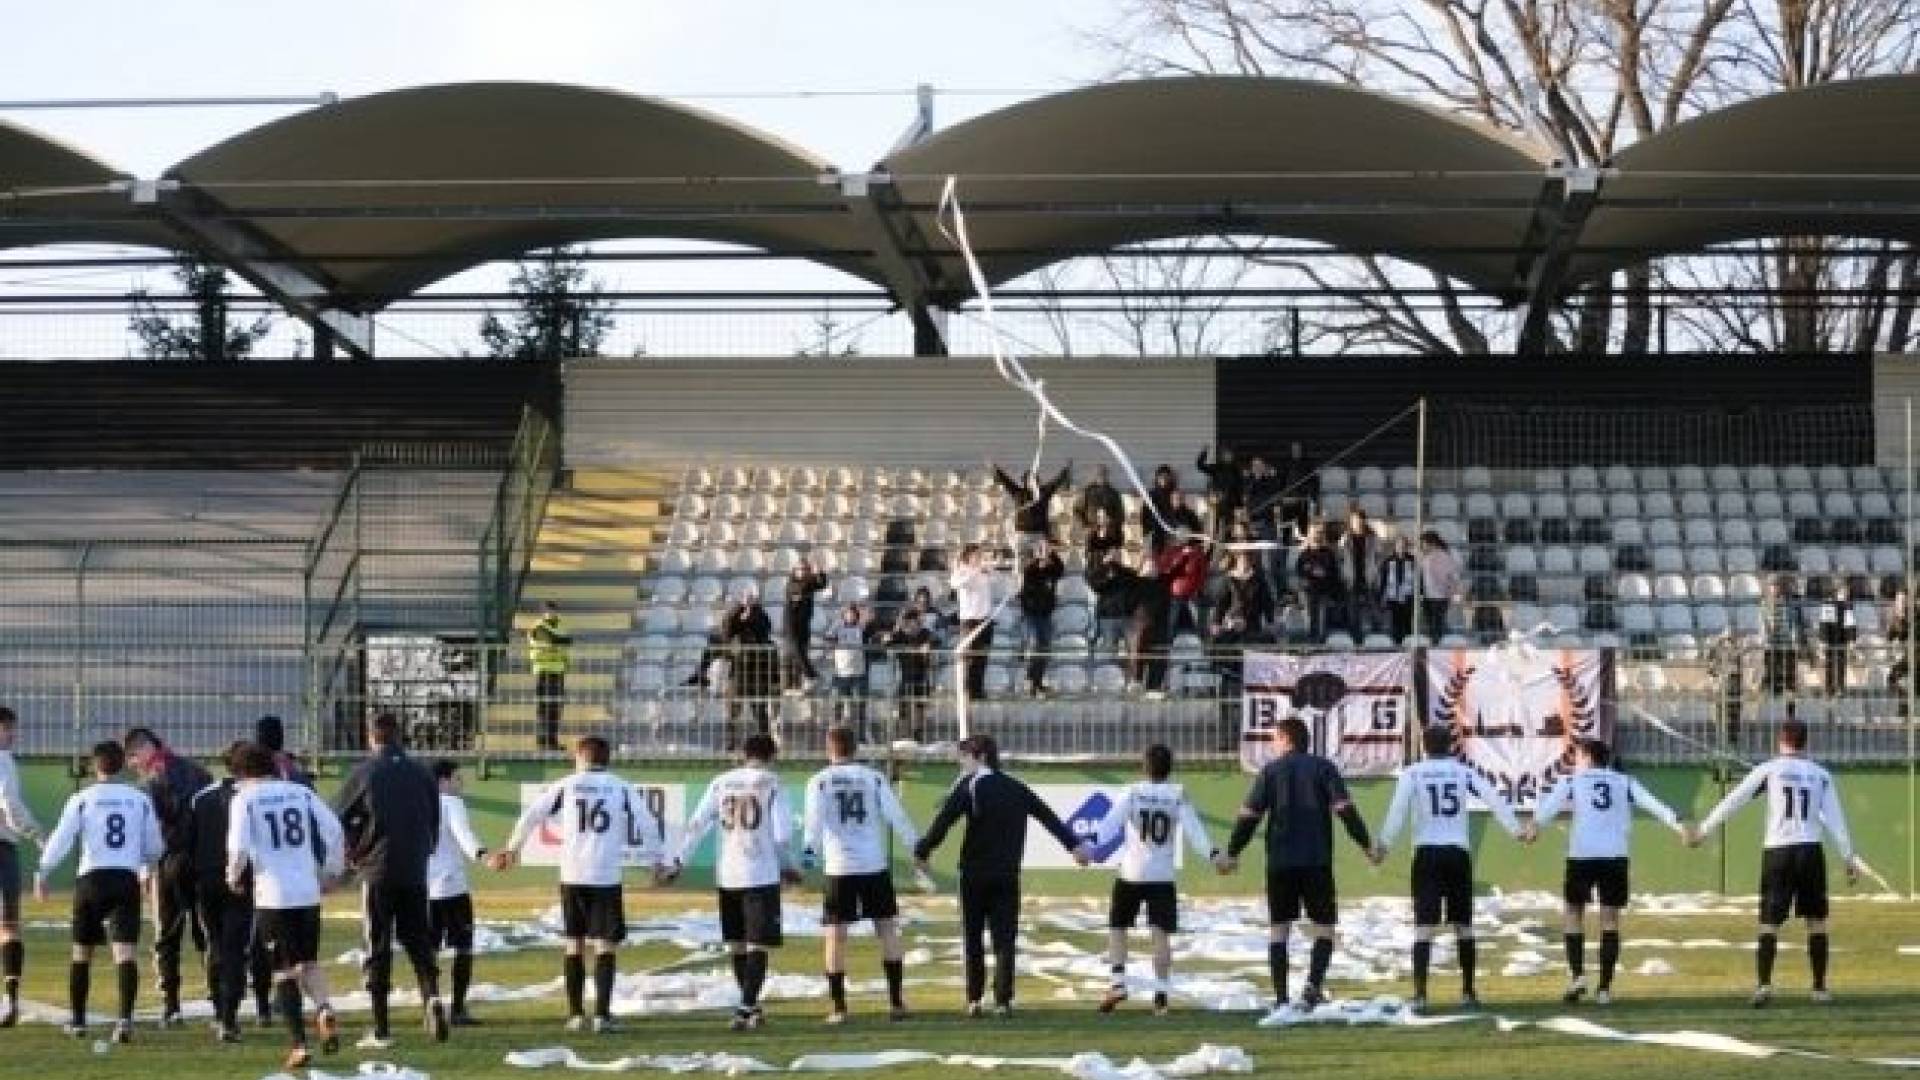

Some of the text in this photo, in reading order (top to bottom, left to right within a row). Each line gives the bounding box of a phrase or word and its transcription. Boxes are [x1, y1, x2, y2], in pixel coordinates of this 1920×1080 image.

[836, 790, 867, 824] 14
[1425, 783, 1460, 817] 15
[1592, 783, 1612, 810] 3
[1782, 787, 1809, 821] 11
[105, 813, 126, 848] 8
[263, 808, 305, 850] 18
[575, 798, 611, 833] 16
[1139, 808, 1168, 846] 10
